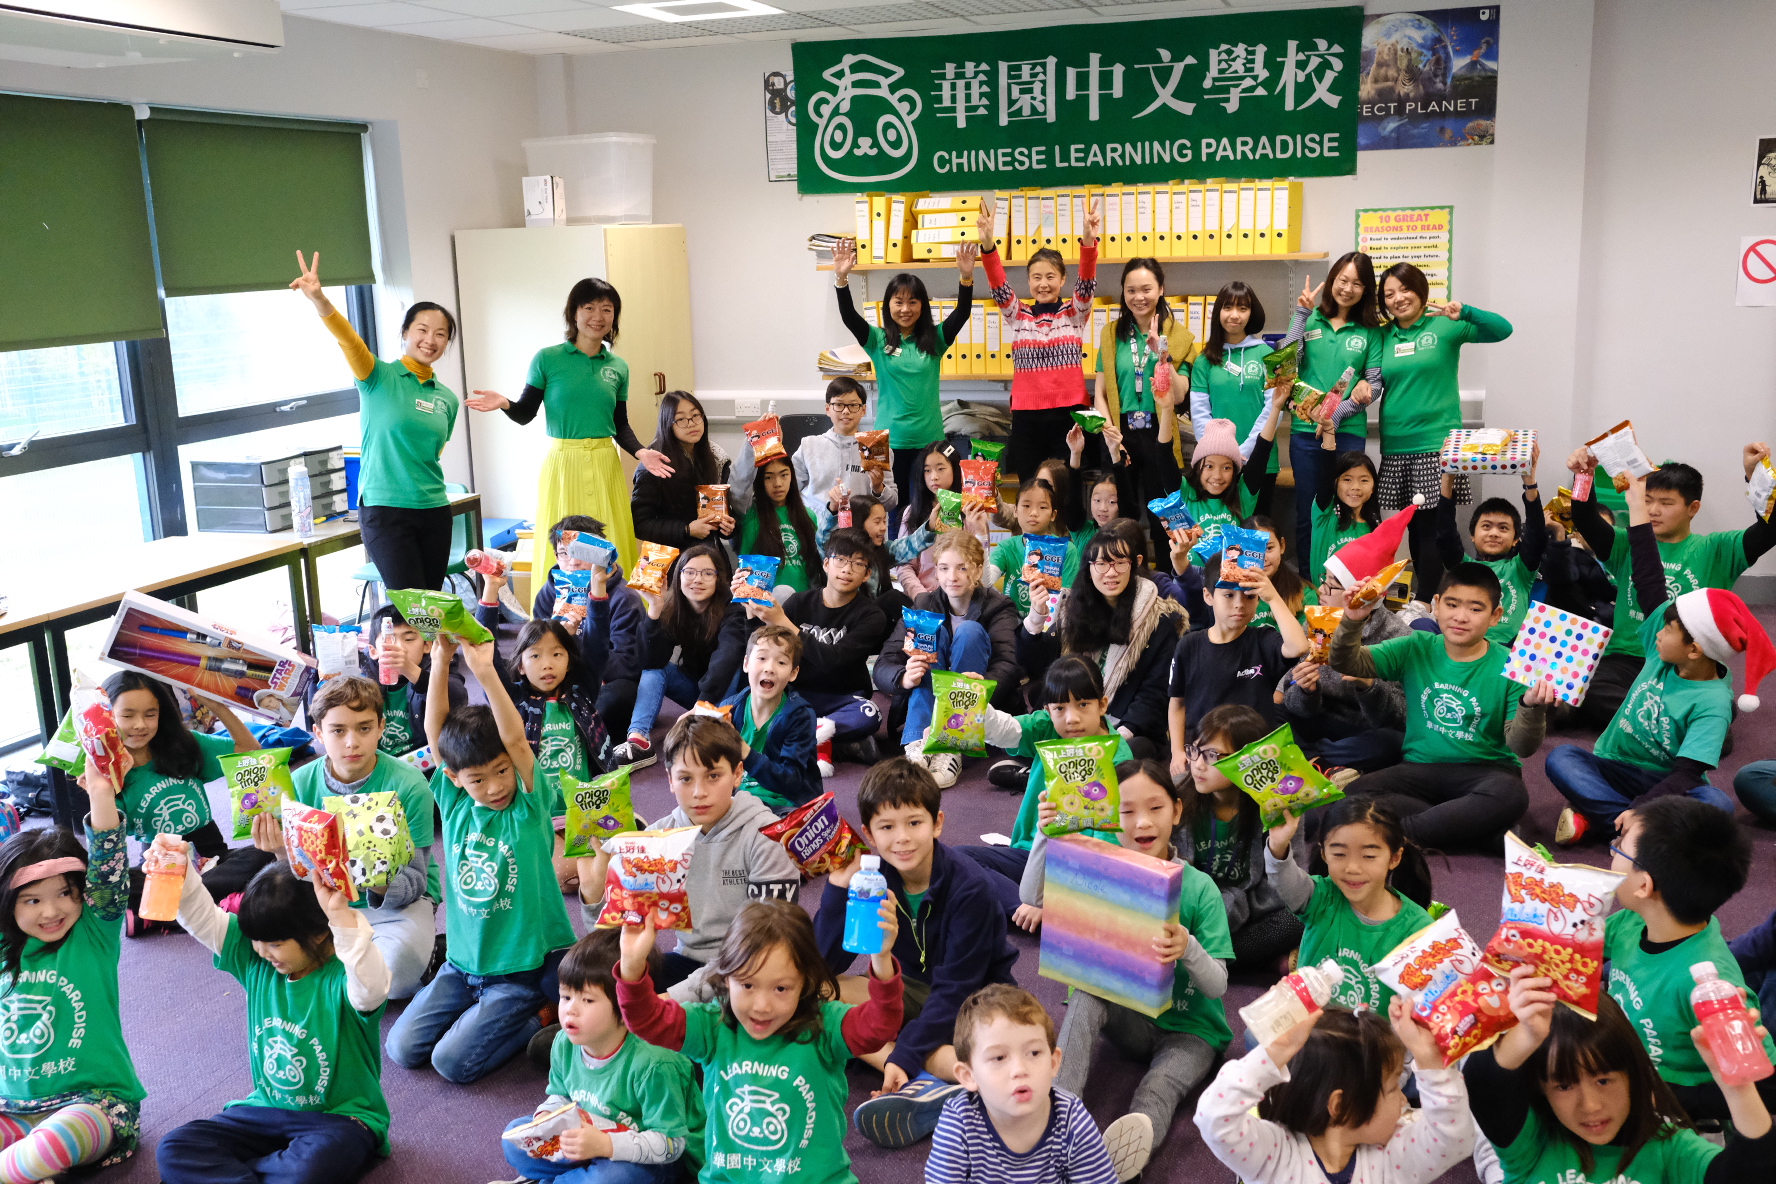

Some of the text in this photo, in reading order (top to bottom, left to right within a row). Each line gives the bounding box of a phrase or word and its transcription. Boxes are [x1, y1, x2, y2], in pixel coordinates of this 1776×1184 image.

[930, 38, 1344, 129] 華園中文學校
[1406, 99, 1479, 113] PLANET
[933, 132, 1340, 174] CHINESE LEARNING PARADISE
[1364, 225, 1403, 233] REASONS
[1421, 223, 1444, 231] READ
[1379, 213, 1430, 223] 10 GREAT
[270, 659, 289, 690] STAR
[276, 661, 297, 692] WARS
[794, 814, 829, 852] Onion
[800, 835, 824, 860] Rings
[722, 869, 746, 878] THE BEST
[1512, 855, 1547, 876] 上好佳
[722, 878, 748, 886] ATHLETE
[748, 883, 798, 905] CITY
[58, 976, 87, 1049] PARADISE
[308, 1037, 331, 1095] PARADISE
[793, 1075, 816, 1149] PARADISE
[712, 1151, 802, 1175] 華園中文學校
